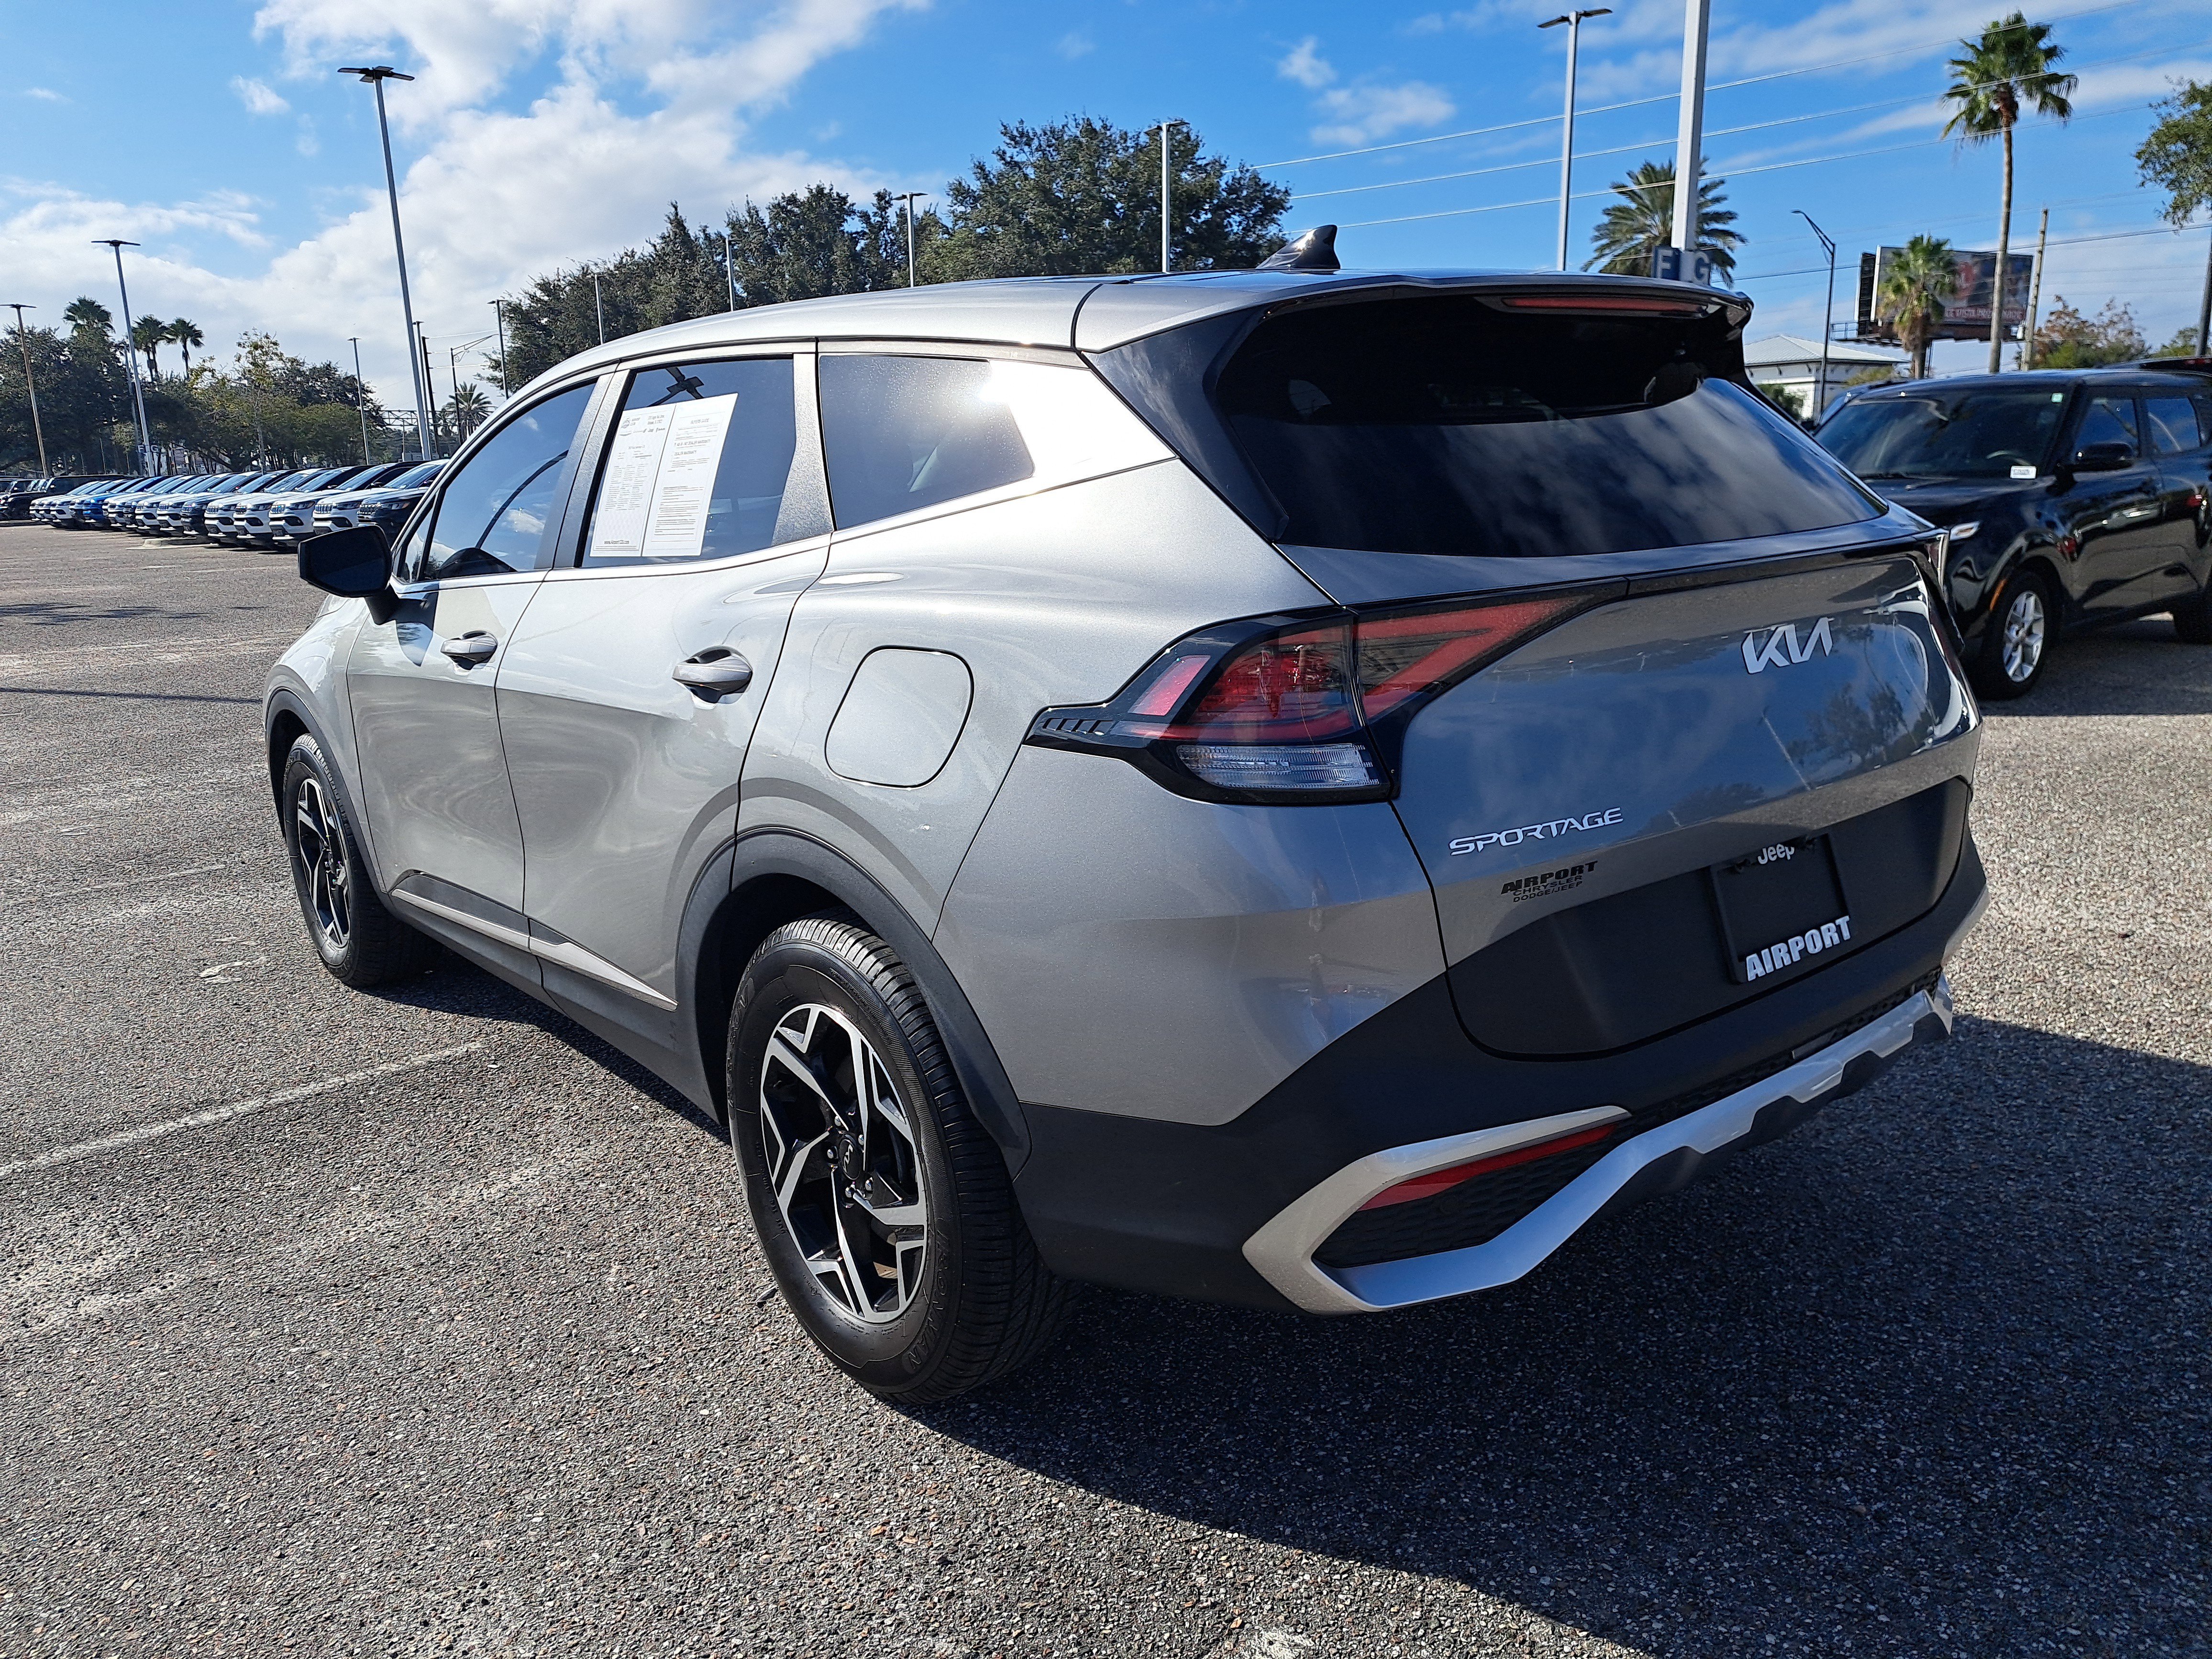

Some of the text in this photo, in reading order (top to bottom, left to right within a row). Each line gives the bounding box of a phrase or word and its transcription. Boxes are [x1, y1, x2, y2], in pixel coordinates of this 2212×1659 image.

[1693, 251, 1710, 283] G
[1742, 617, 1833, 674] KIA
[1449, 807, 1624, 856] SPORTAGE
[1758, 843, 1795, 864] Jeep
[1501, 860, 1598, 895] AIRPORT
[1513, 875, 1583, 896] CHRYSLER
[1513, 881, 1583, 903] DODGE/JEEP
[1746, 915, 1851, 981] AIRPORT
